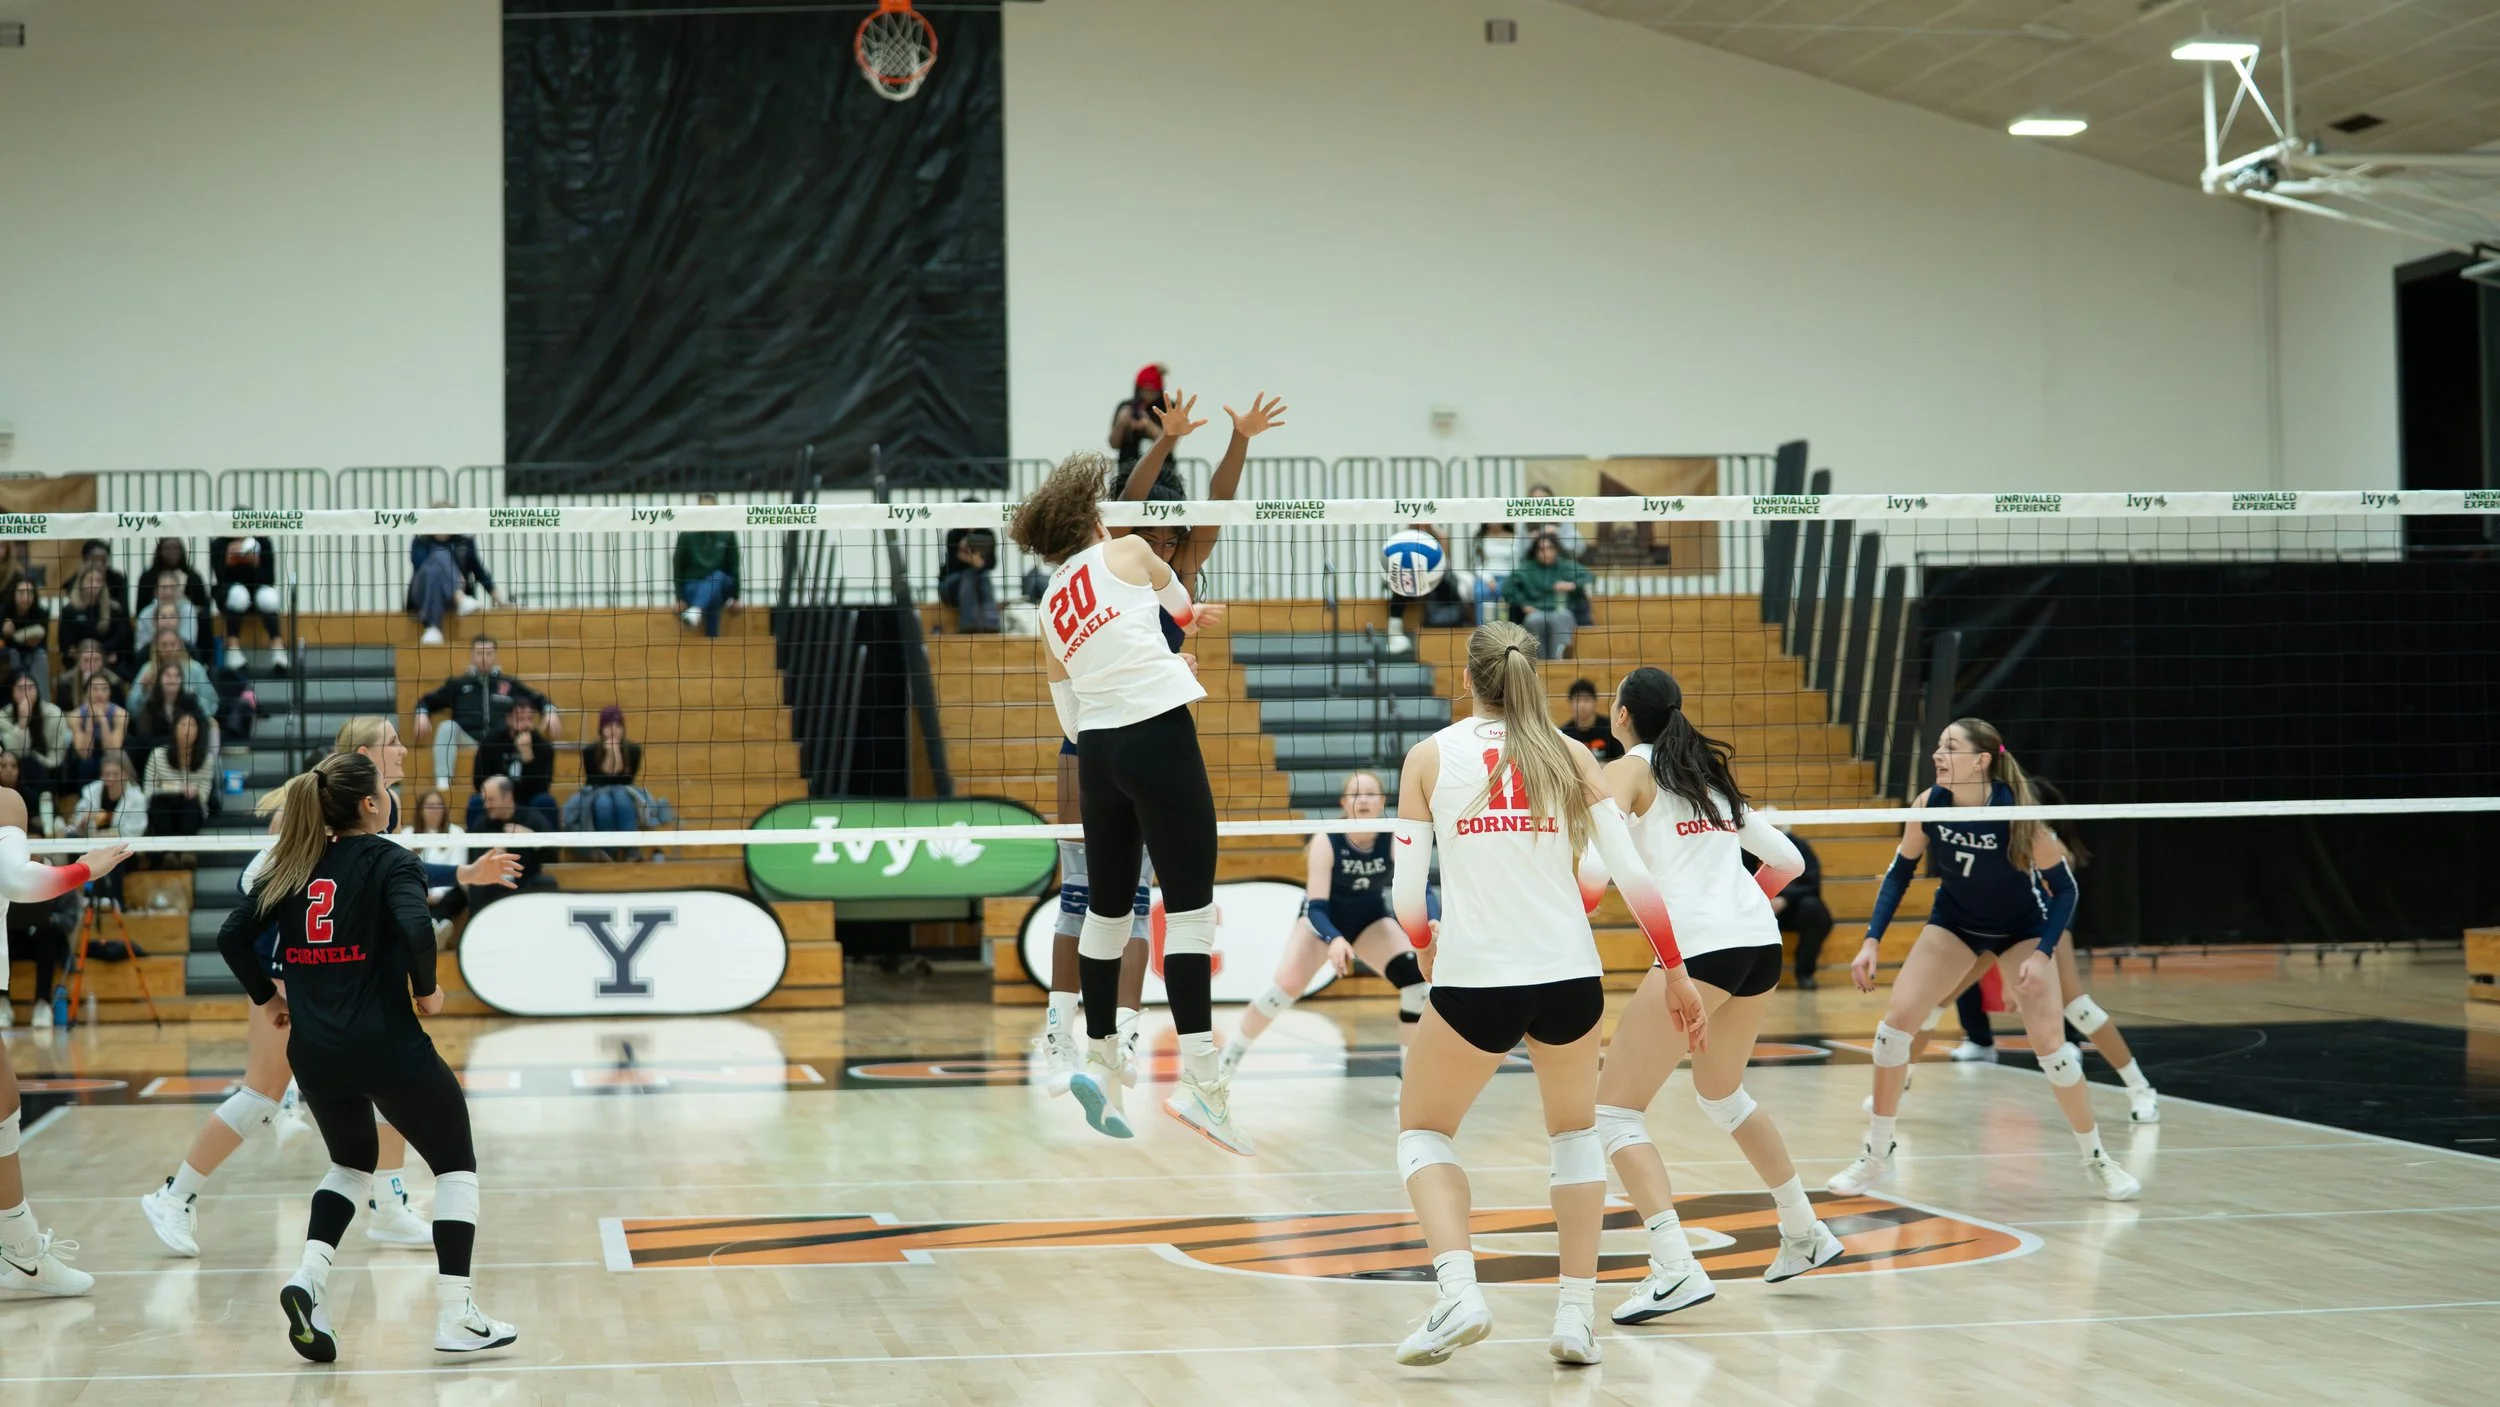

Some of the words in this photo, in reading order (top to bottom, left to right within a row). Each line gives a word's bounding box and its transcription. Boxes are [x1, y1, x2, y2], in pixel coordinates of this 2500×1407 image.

[1506, 498, 1575, 508] UNRIVALED
[1753, 496, 1820, 505] UNRIVALED
[1887, 496, 1914, 512] Ivy
[1995, 494, 2061, 503] UNRIVALED
[2126, 494, 2154, 510] Ivy
[2232, 492, 2297, 502] UNRIVALED
[2360, 492, 2387, 508] Ivy
[489, 508, 561, 518] UNRIVALED
[746, 506, 817, 515] UNRIVALED
[887, 504, 916, 522] Ivy
[1142, 502, 1170, 520] Ivy
[1256, 501, 1325, 510] UNRIVALED
[1394, 500, 1422, 518] Ivy
[1506, 508, 1575, 517] EXPERIENCE
[1643, 497, 1670, 514] Ivy
[1753, 505, 1820, 514] EXPERIENCE
[1995, 503, 2061, 512] EXPERIENCE
[2232, 502, 2297, 511] EXPERIENCE
[0, 515, 47, 525] IVALED
[117, 513, 146, 531] Ivy
[232, 511, 304, 520] UNRIVALED
[374, 510, 402, 528] Ivy
[489, 518, 561, 527] EXPERIENCE
[631, 508, 659, 524] Ivy
[746, 515, 817, 525] EXPERIENCE
[1256, 510, 1325, 519] EXPERIENCE
[232, 520, 304, 530] EXPERIENCE
[1049, 563, 1097, 645] 20
[1489, 729, 1503, 738] Ivy
[1482, 748, 1530, 810] 11
[1456, 815, 1559, 836] CORNELL
[1937, 824, 1998, 850] YALE
[810, 816, 920, 877] Ivy
[1341, 856, 1386, 876] YALE
[1954, 850, 1976, 878] 7
[305, 878, 338, 944] 2
[285, 945, 367, 965] CORNELL
[568, 906, 678, 999] Y
